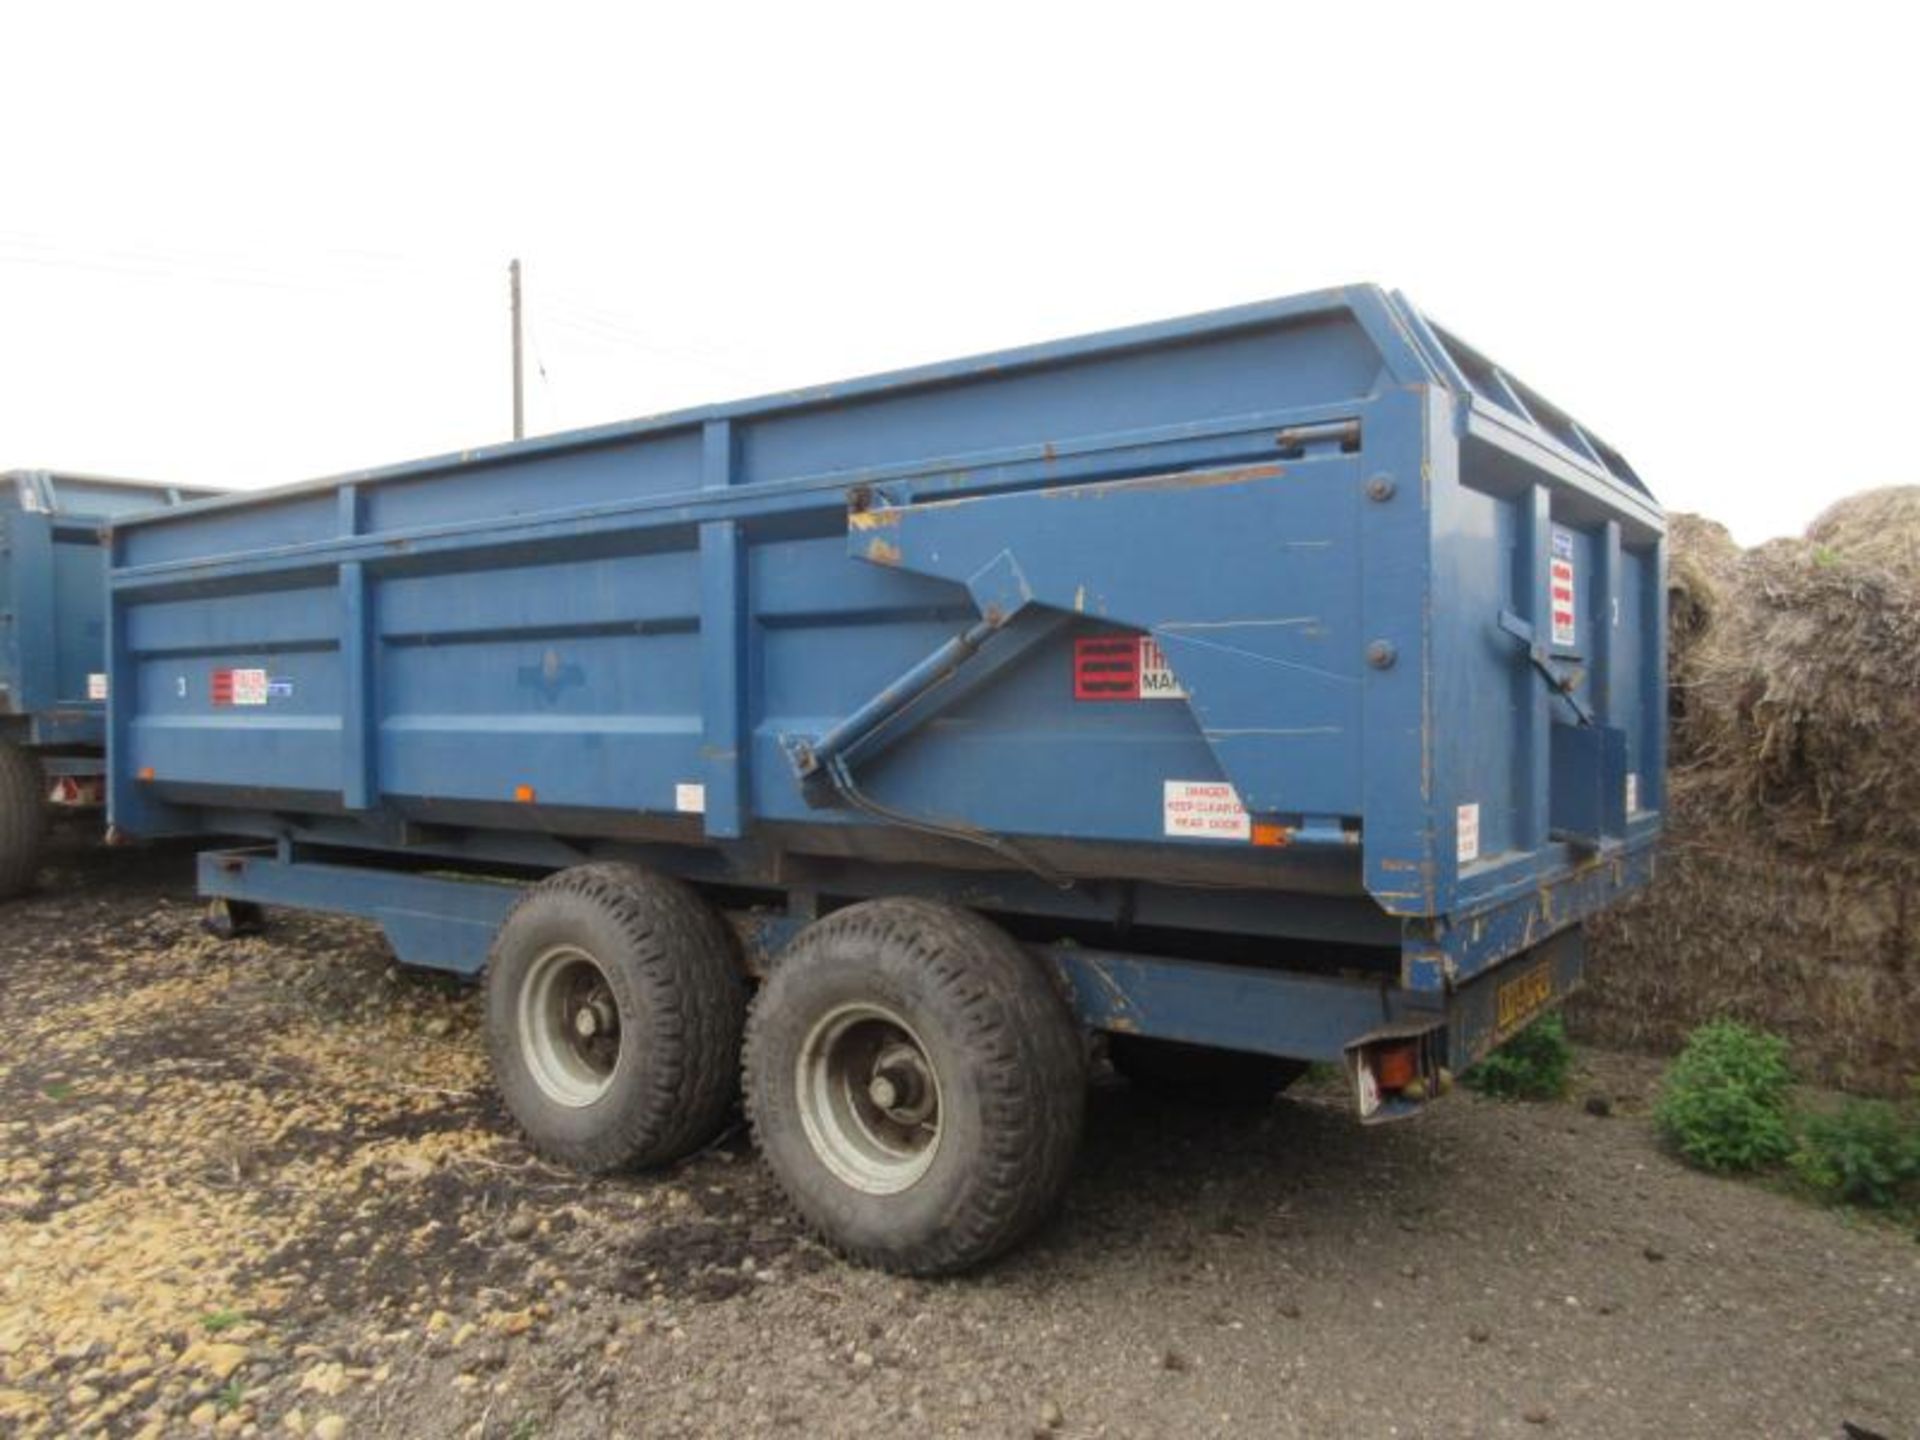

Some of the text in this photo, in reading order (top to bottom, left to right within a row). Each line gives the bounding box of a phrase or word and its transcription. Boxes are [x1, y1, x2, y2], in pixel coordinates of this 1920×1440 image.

[1184, 785, 1230, 798] DANGER
[1194, 801, 1231, 814] CLEAR
[1208, 817, 1241, 830] DOOR
